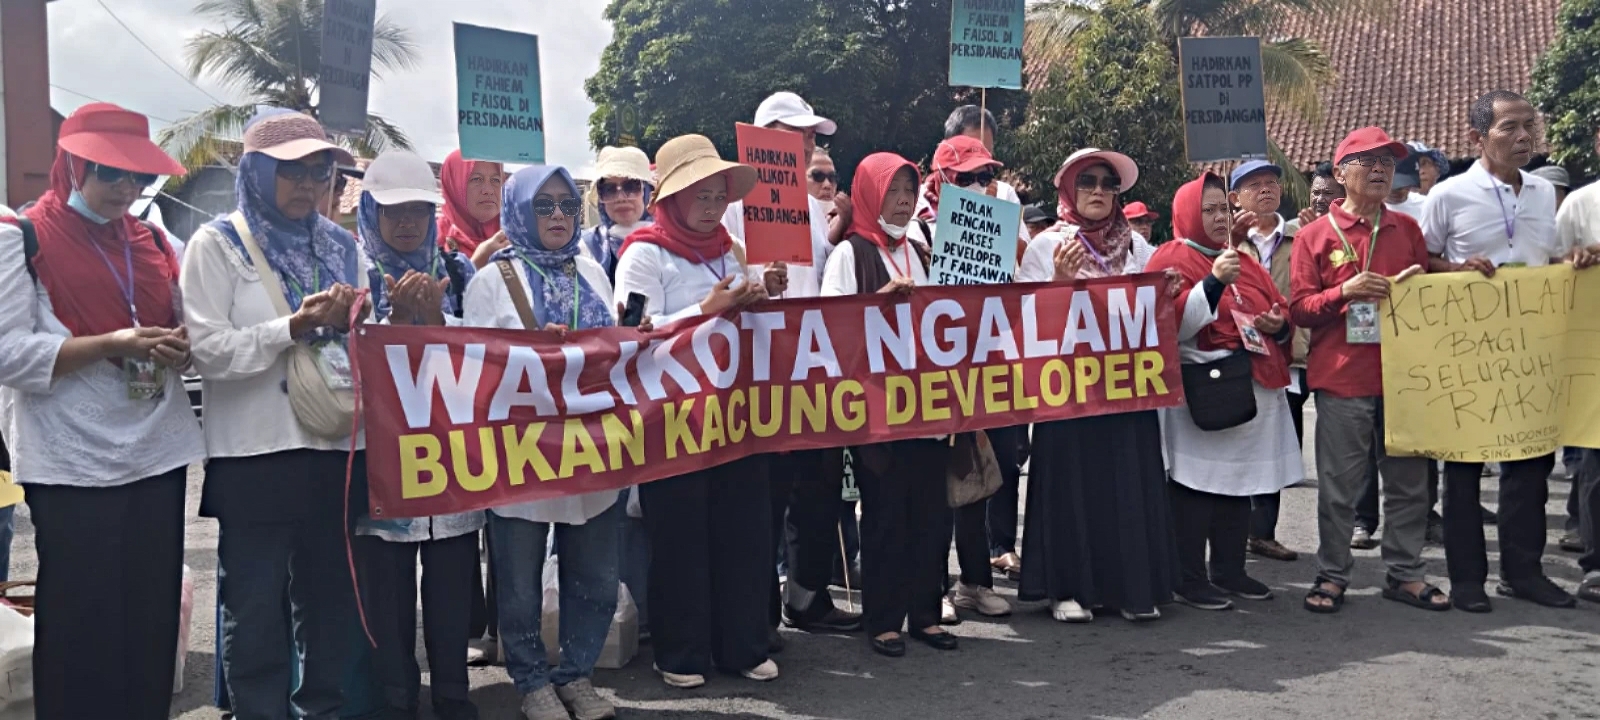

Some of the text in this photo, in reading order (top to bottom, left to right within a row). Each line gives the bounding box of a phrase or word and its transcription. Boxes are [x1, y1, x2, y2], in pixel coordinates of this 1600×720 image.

[968, 13, 1010, 28] FAHIEM
[963, 28, 998, 42] FAISOL
[951, 43, 1022, 60] PERSIDANGAN
[467, 56, 529, 77] HADIRKAN
[1191, 56, 1252, 71] HADIRKAN
[475, 74, 524, 94] FAHIEM
[1188, 73, 1253, 88] SATPOL PP
[471, 92, 530, 112] FAISOL DI
[459, 109, 543, 131] PERSIDANGAN
[1185, 108, 1265, 124] PERSIDANGAN
[746, 146, 797, 168] HADIRKAN
[757, 168, 798, 187] ALIKOTA
[743, 205, 810, 225] PERSIDANGAN
[960, 198, 993, 218] TOLAK
[950, 211, 1001, 236] RENCANA
[960, 230, 994, 249] AKSES
[943, 241, 1002, 268] DEVELOPER
[932, 254, 1014, 283] PT FARSAWAN
[1386, 275, 1577, 337] KEADILAN
[1434, 327, 1526, 357] BAGI
[384, 285, 1160, 429] WALIKOTA NGALAM
[1397, 352, 1554, 395] SELURUH
[399, 351, 1170, 500] BUKAN KACUNG DEVELOPER
[1481, 446, 1511, 460] SING
